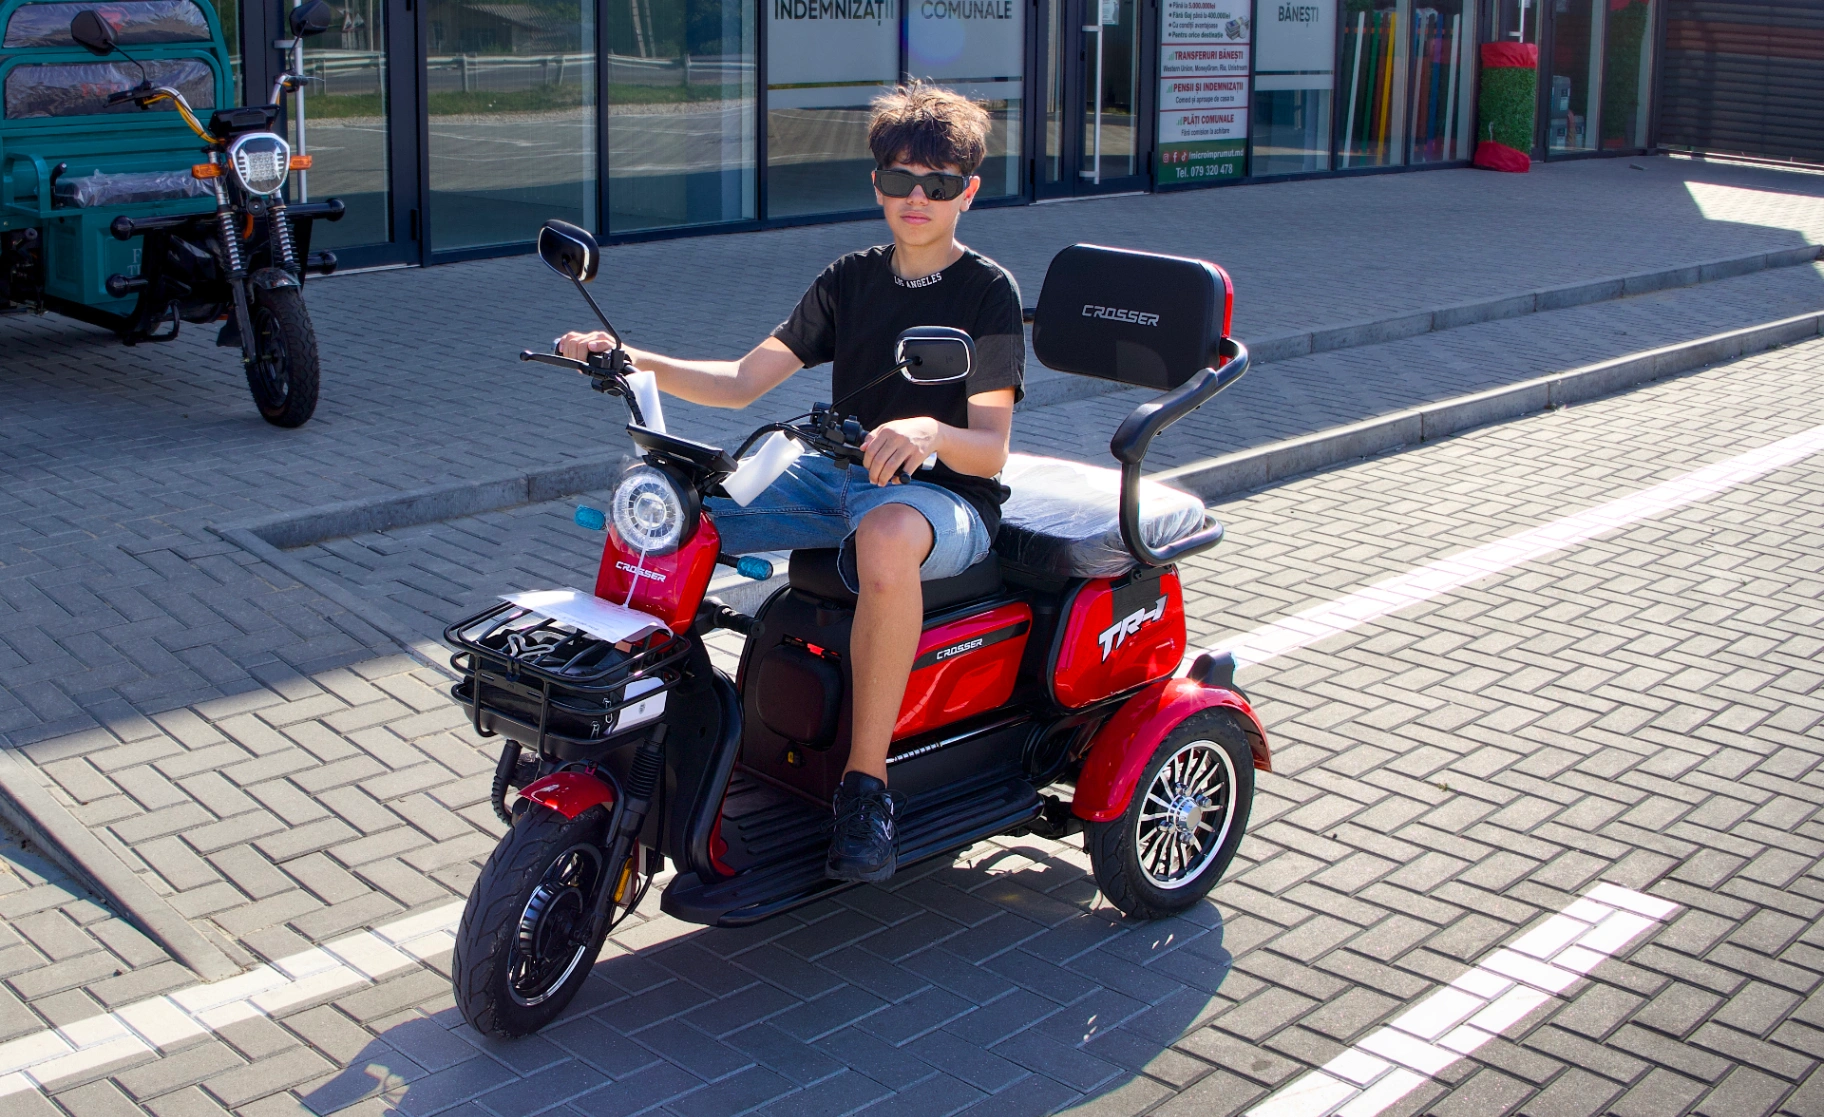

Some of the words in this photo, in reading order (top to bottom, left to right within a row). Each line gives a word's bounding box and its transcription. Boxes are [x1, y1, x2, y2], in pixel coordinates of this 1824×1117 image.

[774, 0, 894, 26] INDEMNIZAȚII
[921, 0, 1012, 19] COMUNALE
[1278, 2, 1319, 27] BĂNEȘTI
[1172, 31, 1188, 39] Pentru
[1174, 51, 1218, 61] TRANSFERURI
[1218, 48, 1244, 63] BĂNEȘTI
[1163, 65, 1180, 73] Western
[1173, 83, 1194, 93] PENSII
[1203, 82, 1244, 94] INDEMNIZAȚII
[1214, 95, 1220, 103] de
[1183, 113, 1200, 127] PLĂȚI
[1201, 114, 1235, 125] COMUNALE
[1191, 128, 1209, 136] comision
[1214, 127, 1230, 135] achitare
[1175, 167, 1189, 178] Tel.
[1190, 165, 1204, 177] 079
[1205, 164, 1219, 176] 320
[1220, 163, 1233, 175] 478
[906, 272, 943, 289] ANGELES
[1081, 304, 1160, 327] CROSSER
[615, 560, 667, 583] CROSSER
[936, 638, 983, 660] CROSSER
